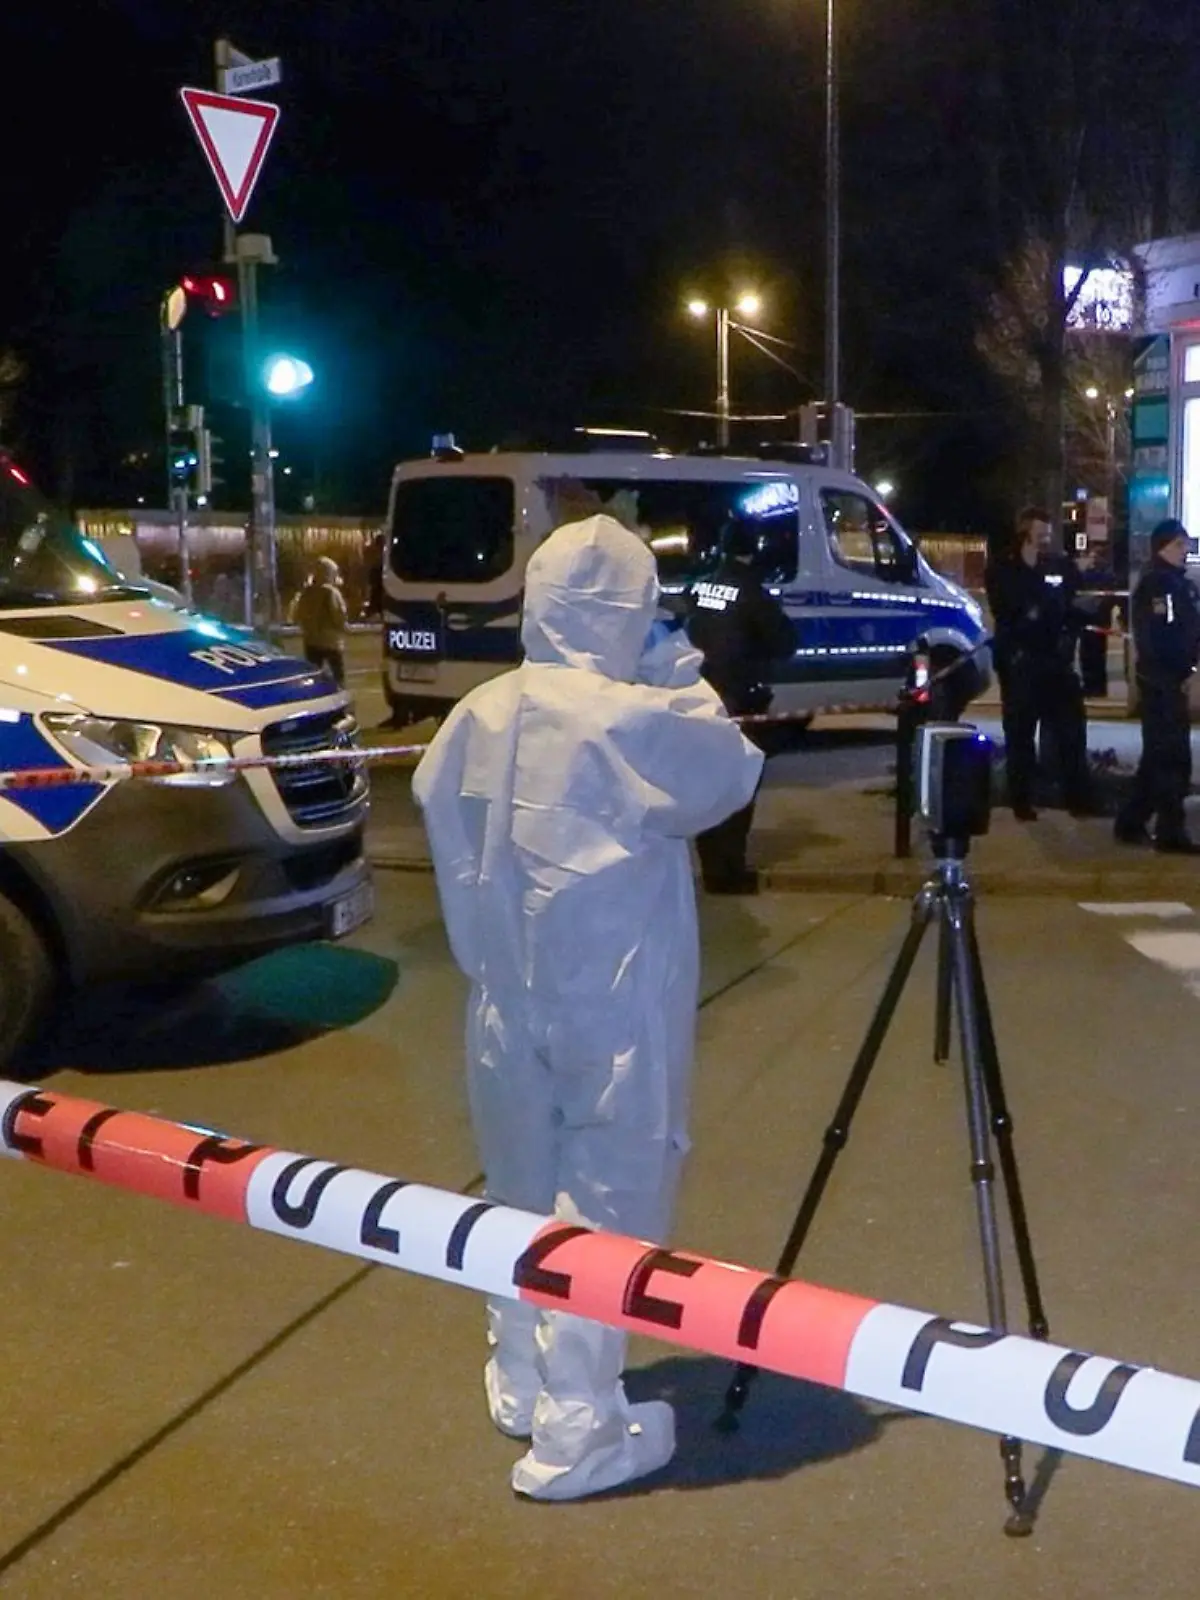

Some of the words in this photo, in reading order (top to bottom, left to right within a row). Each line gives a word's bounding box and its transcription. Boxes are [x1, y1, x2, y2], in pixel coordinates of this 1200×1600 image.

[690, 582, 740, 602] POLIZEI
[389, 630, 436, 650] POLIZEI
[901, 1316, 1200, 1461] PO
